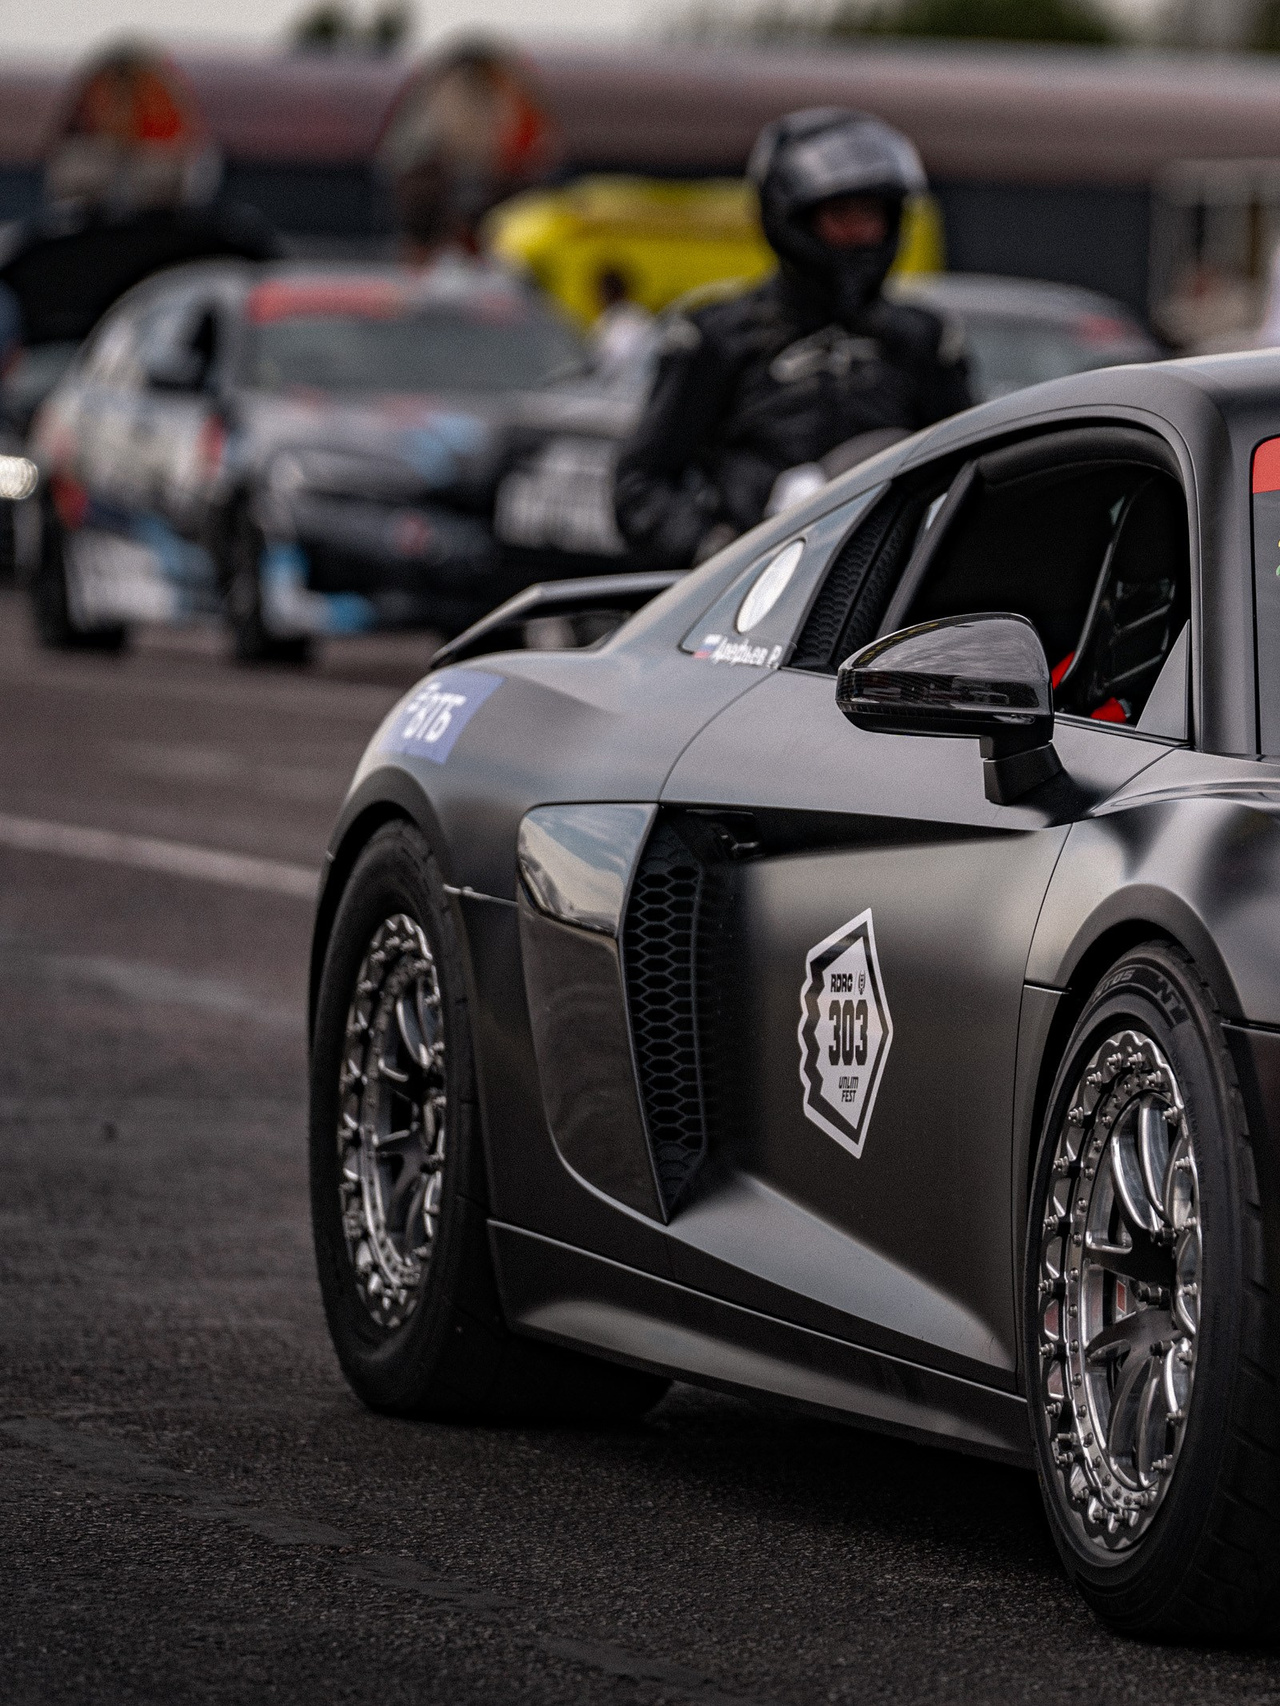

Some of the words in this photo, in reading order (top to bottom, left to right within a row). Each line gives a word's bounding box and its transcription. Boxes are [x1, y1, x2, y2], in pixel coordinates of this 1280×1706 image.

[830, 973, 853, 993] RDRC
[828, 999, 868, 1066] 303
[841, 1089, 857, 1103] FEST
